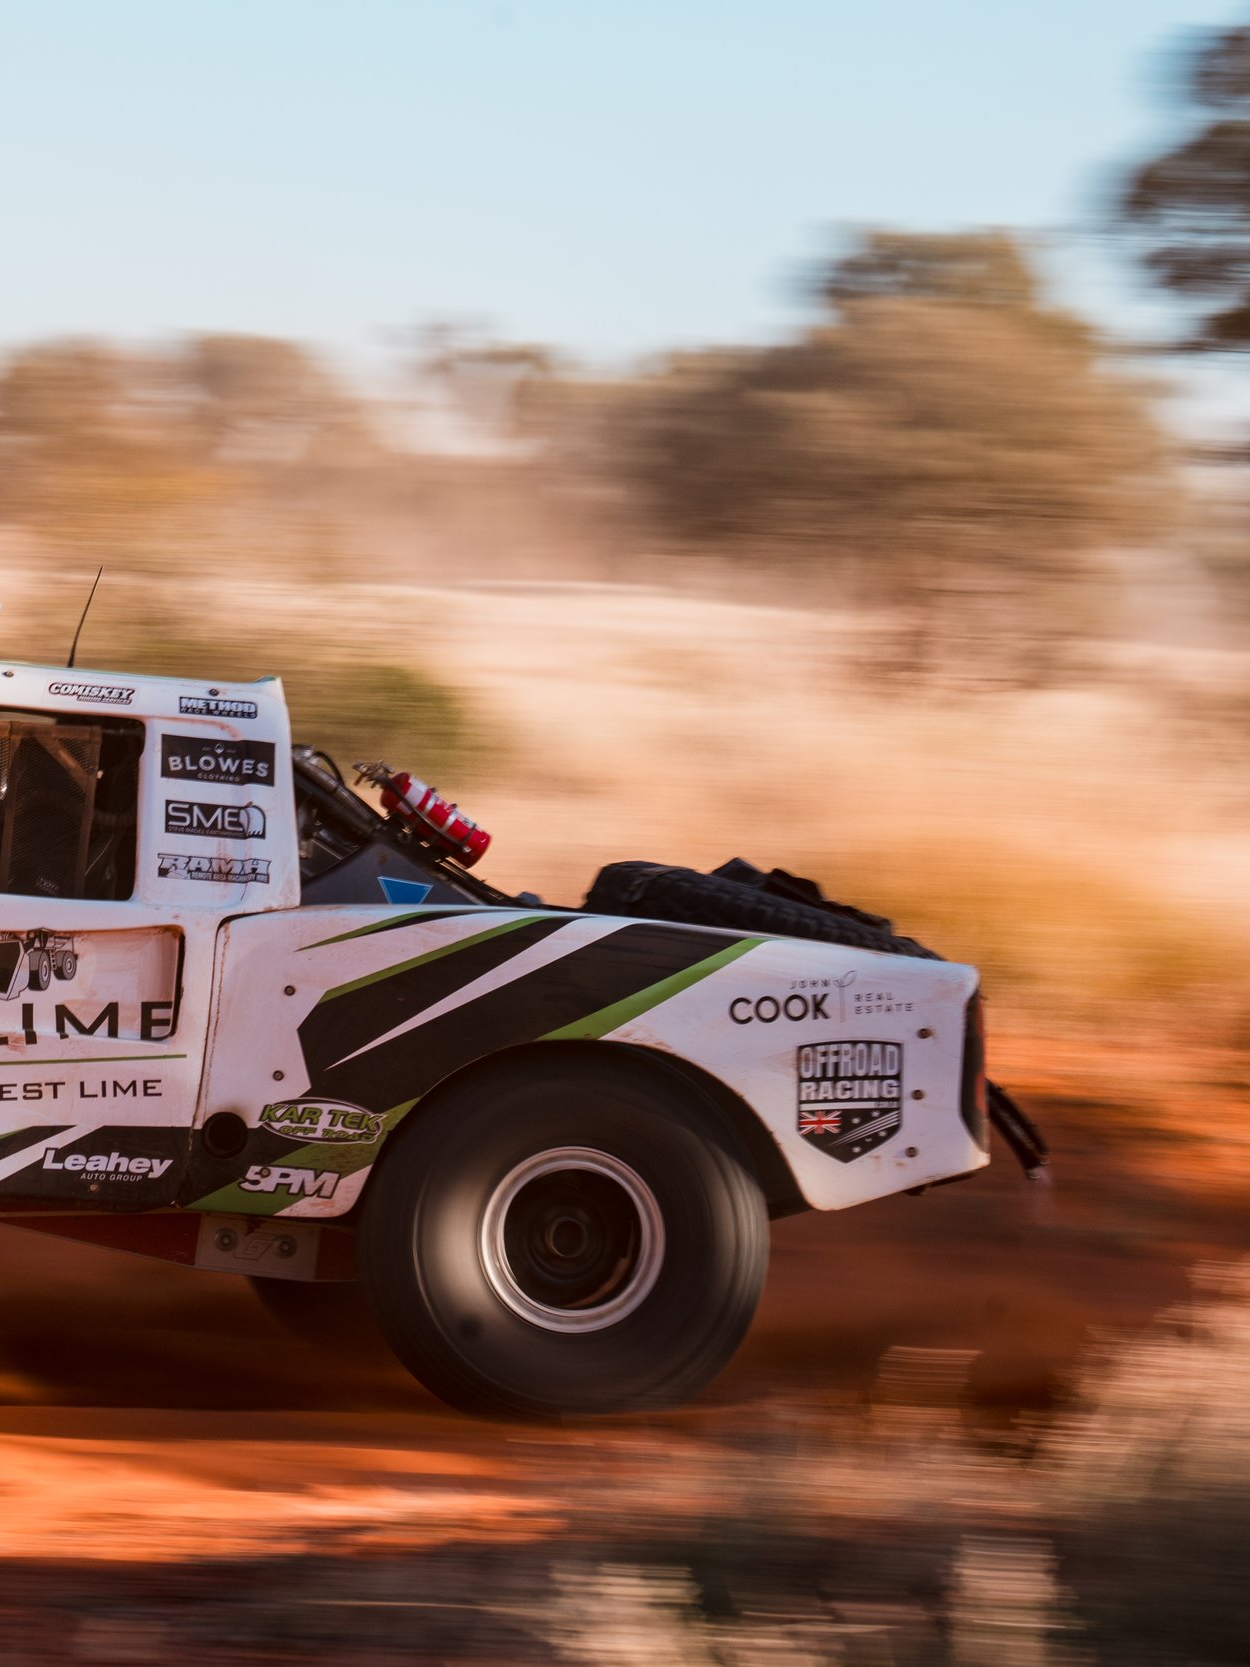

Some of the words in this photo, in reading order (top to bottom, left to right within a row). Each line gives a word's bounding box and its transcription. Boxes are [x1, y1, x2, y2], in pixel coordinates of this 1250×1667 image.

[49, 683, 135, 699] COMISKEY
[180, 698, 256, 713] METHOD
[168, 755, 270, 777] BLOWES
[197, 773, 240, 782] CLOTHING
[168, 802, 243, 831] SME
[790, 980, 830, 989] JOHN
[855, 993, 894, 1002] REAL
[729, 994, 830, 1025] COOK
[855, 1003, 914, 1014] ESTATE
[800, 1043, 899, 1078] OFFROAD
[80, 1079, 162, 1099] LIME
[800, 1080, 900, 1100] RACING
[259, 1104, 323, 1124] KAR
[328, 1109, 384, 1132] TEK
[279, 1126, 317, 1136] OFF
[321, 1128, 377, 1141] ROAD
[43, 1150, 173, 1178] Leahey
[81, 1173, 106, 1181] AUTO
[109, 1174, 143, 1182] GROUP
